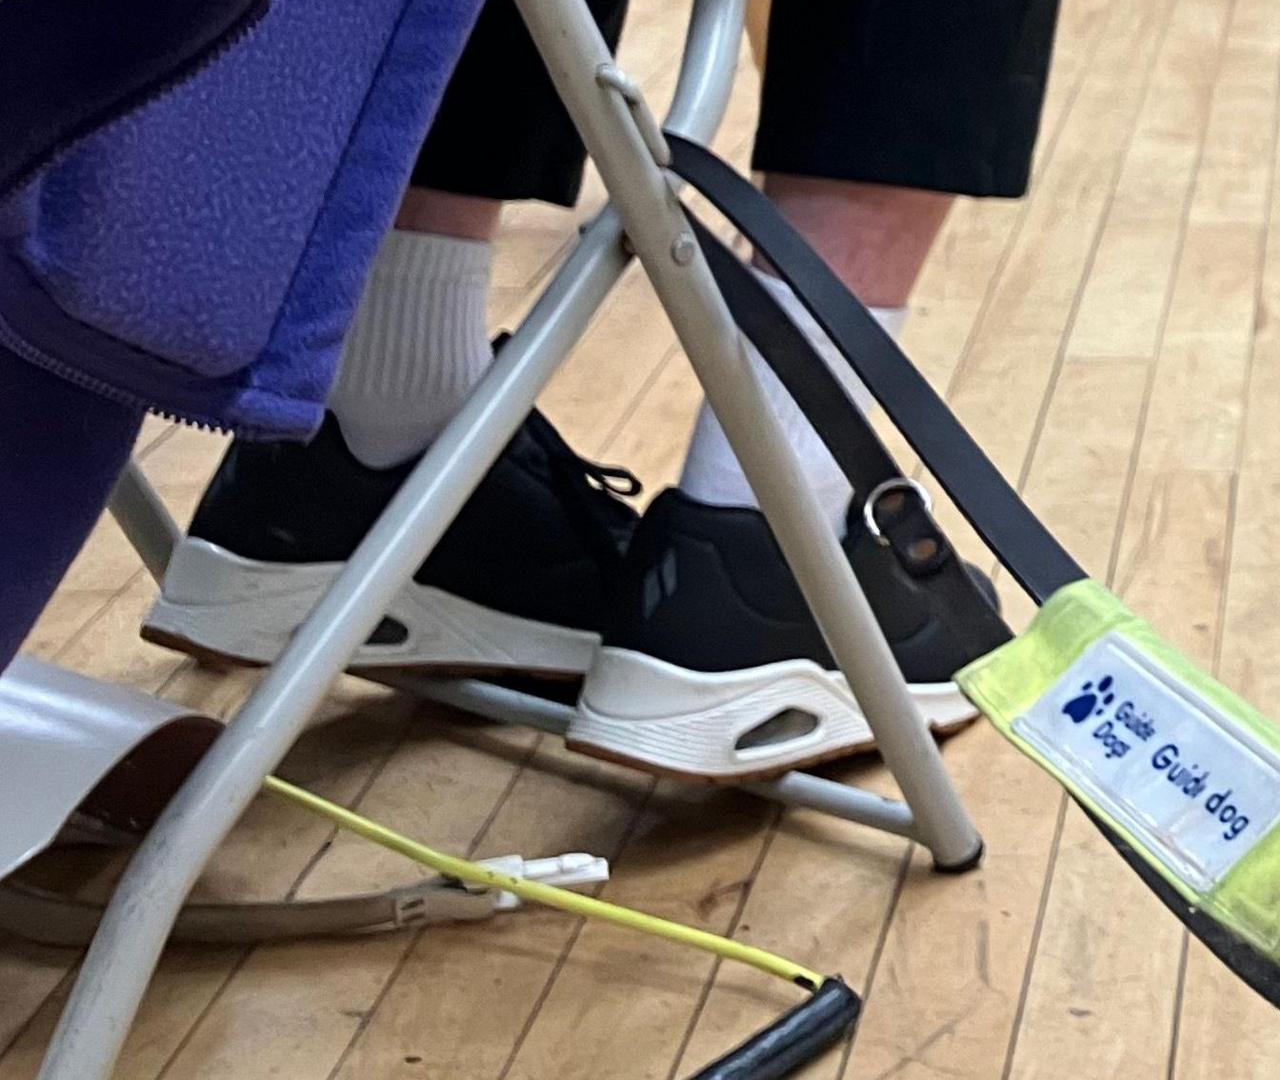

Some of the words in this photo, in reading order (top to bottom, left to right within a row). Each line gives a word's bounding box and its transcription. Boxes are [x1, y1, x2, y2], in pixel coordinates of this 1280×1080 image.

[1093, 721, 1131, 759] Dogs
[1115, 701, 1156, 742] Guide
[1204, 788, 1249, 841] dog
